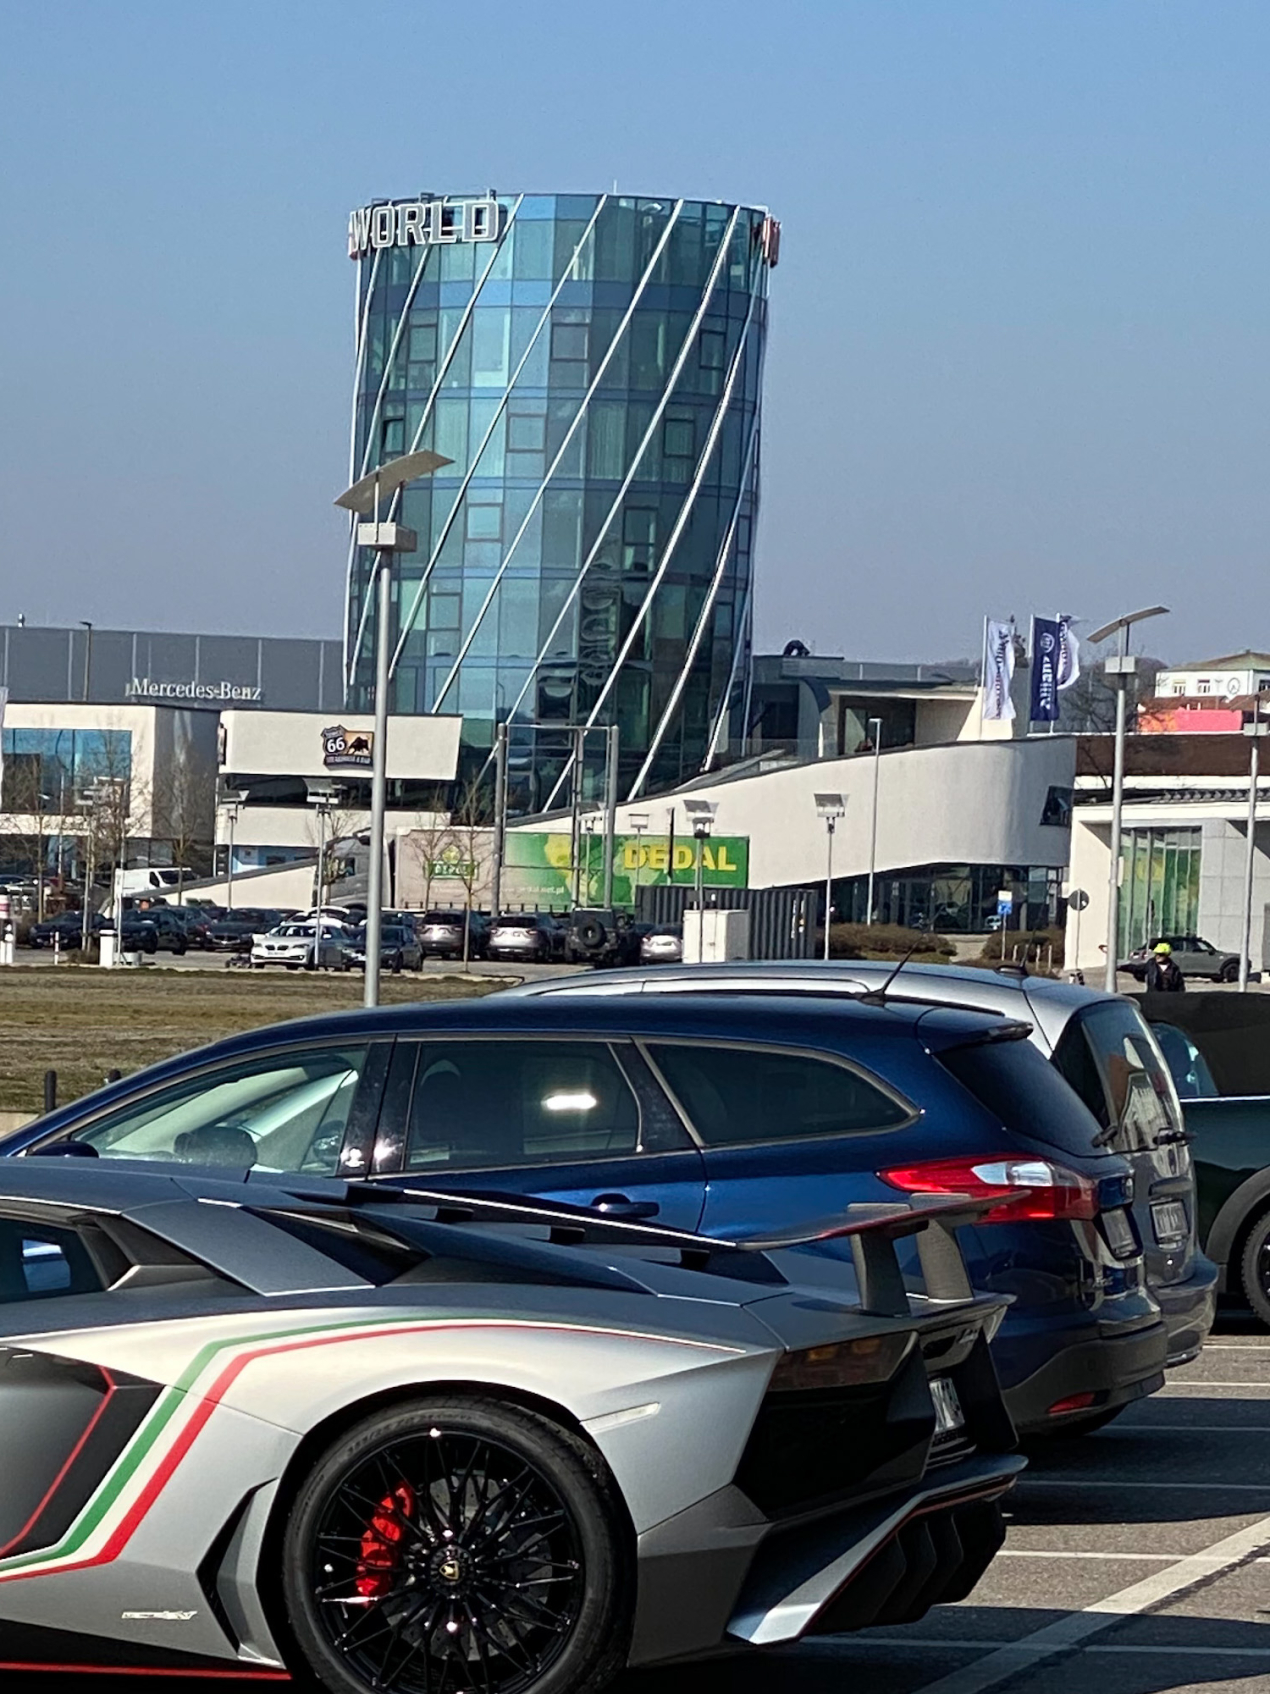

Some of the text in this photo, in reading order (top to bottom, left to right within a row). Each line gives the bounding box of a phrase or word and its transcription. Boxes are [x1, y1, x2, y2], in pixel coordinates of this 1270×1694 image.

[350, 200, 499, 252] WORLD
[130, 677, 262, 700] Mercedes-Benz
[1039, 656, 1053, 710] Allianz
[327, 737, 345, 753] 66
[624, 843, 737, 872] DEDAL
